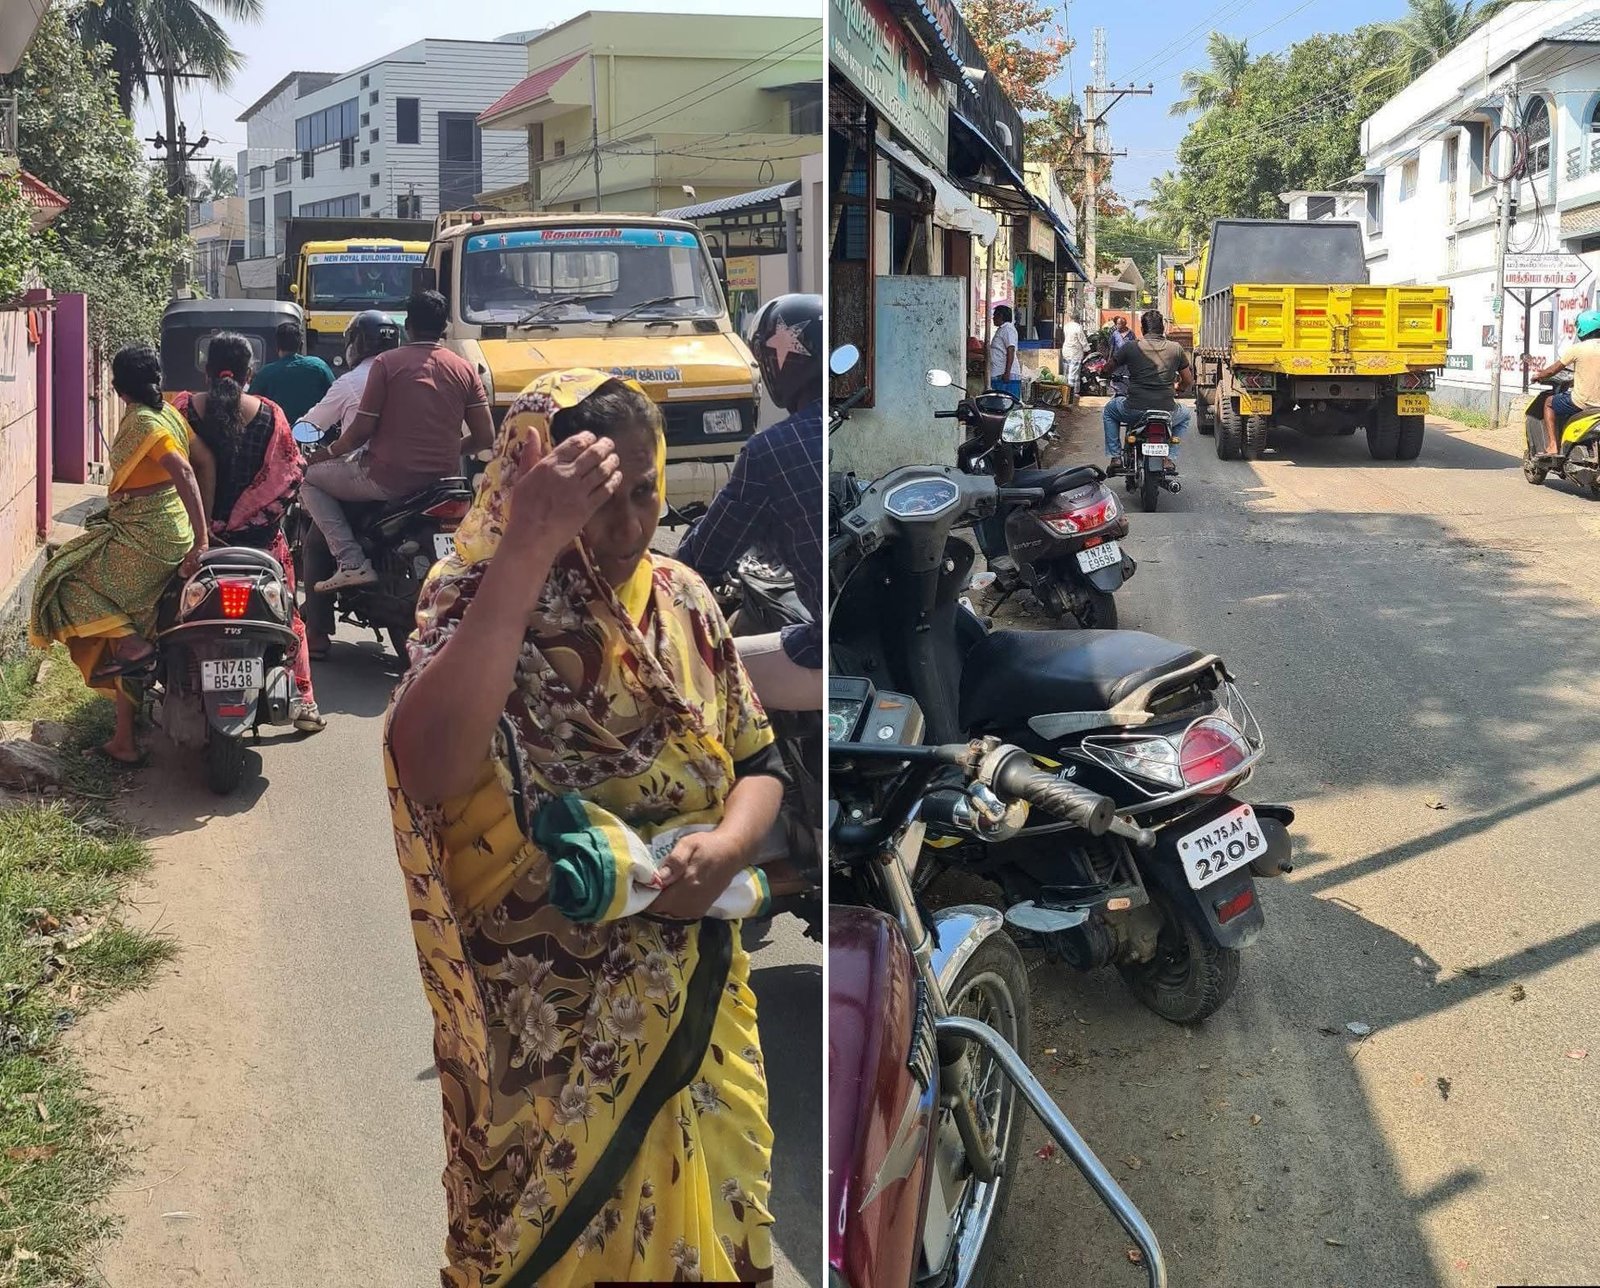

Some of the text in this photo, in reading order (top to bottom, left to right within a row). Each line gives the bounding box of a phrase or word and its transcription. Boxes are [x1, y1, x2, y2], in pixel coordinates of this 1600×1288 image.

[340, 254, 359, 262] ROYAL
[361, 254, 391, 262] BUILDING
[1327, 365, 1357, 374] TATA
[223, 627, 243, 635] TVS
[213, 661, 252, 675] TN74B
[214, 674, 253, 689] B5438
[1195, 831, 1260, 880] 2206
